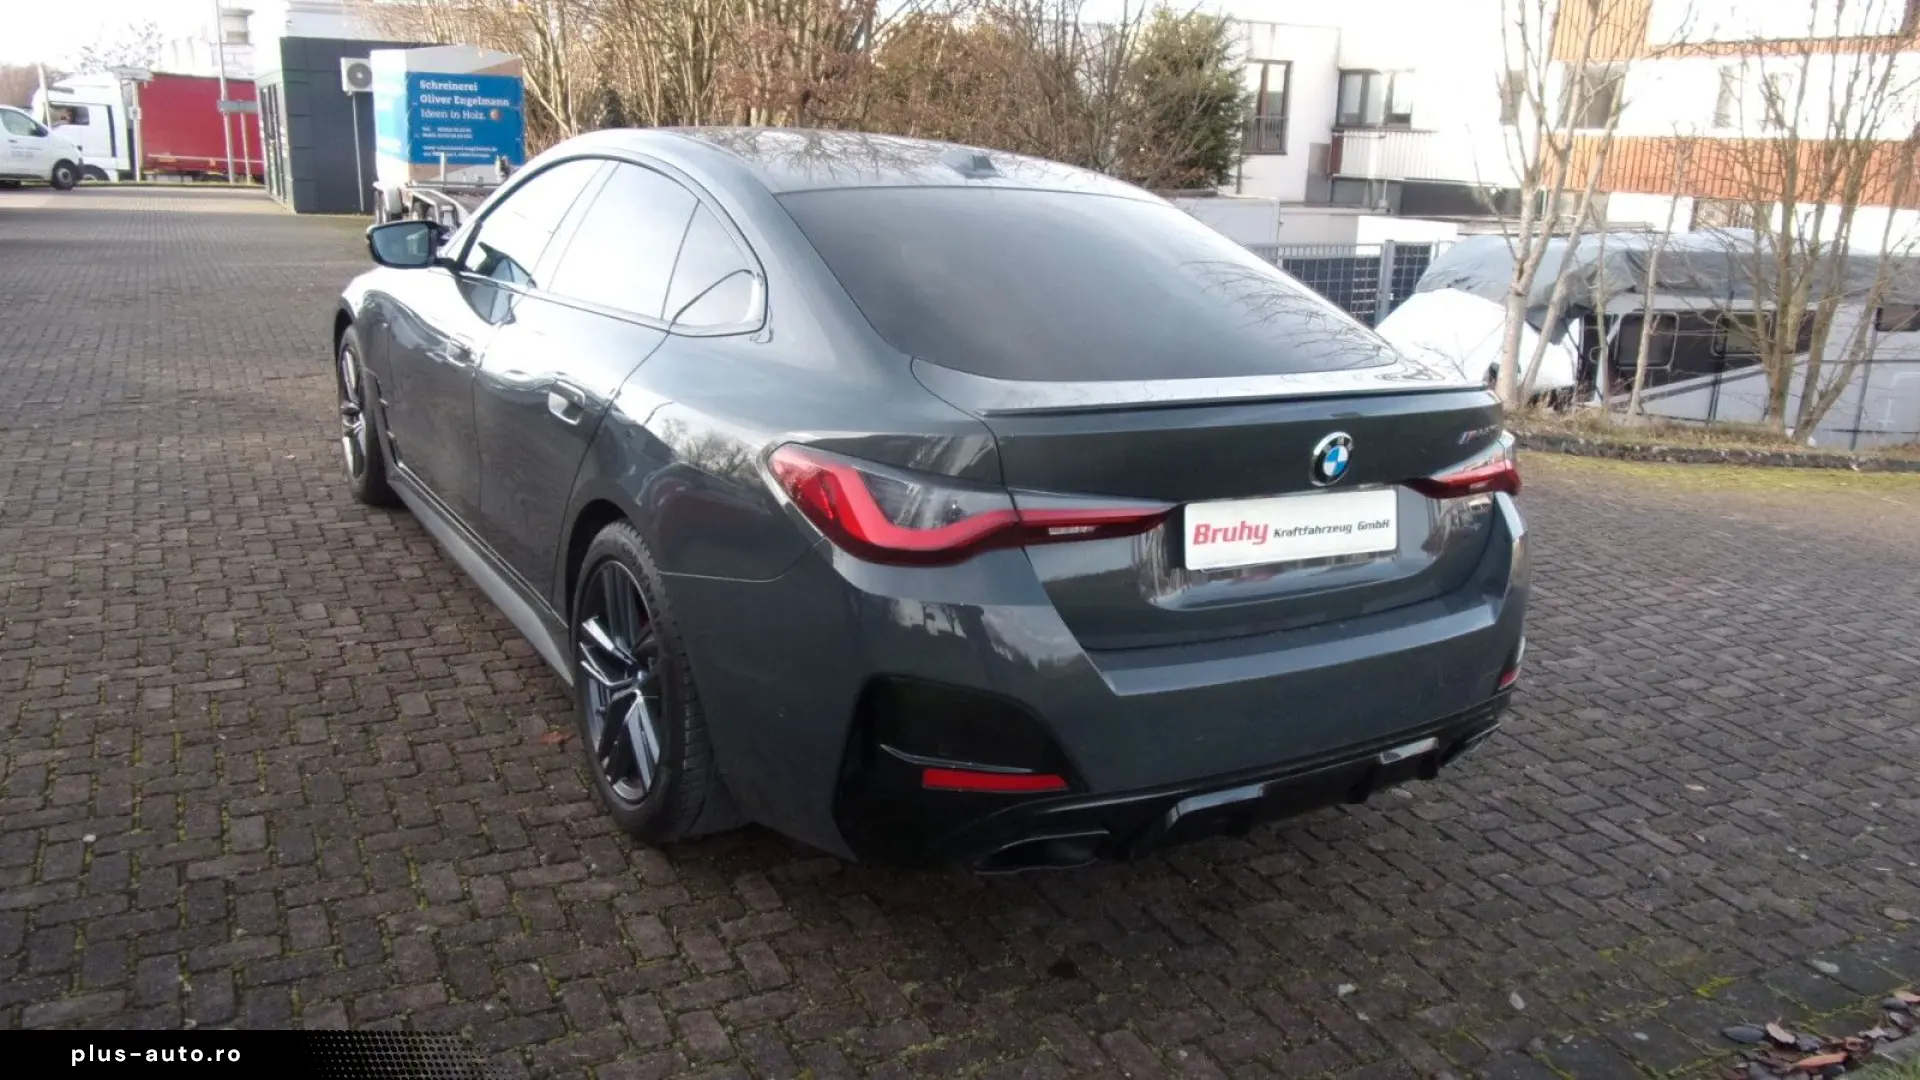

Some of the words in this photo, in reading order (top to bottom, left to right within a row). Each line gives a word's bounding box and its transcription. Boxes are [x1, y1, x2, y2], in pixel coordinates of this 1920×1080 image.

[420, 80, 478, 91] Schreinerei
[420, 94, 452, 104] Oliver
[454, 96, 510, 107] Engelmann
[421, 109, 448, 119] Ideen
[450, 110, 460, 119] in
[1193, 520, 1268, 545] Bruhy
[1273, 524, 1352, 538] Kraftfahrzeug
[1357, 519, 1389, 531] GmbH
